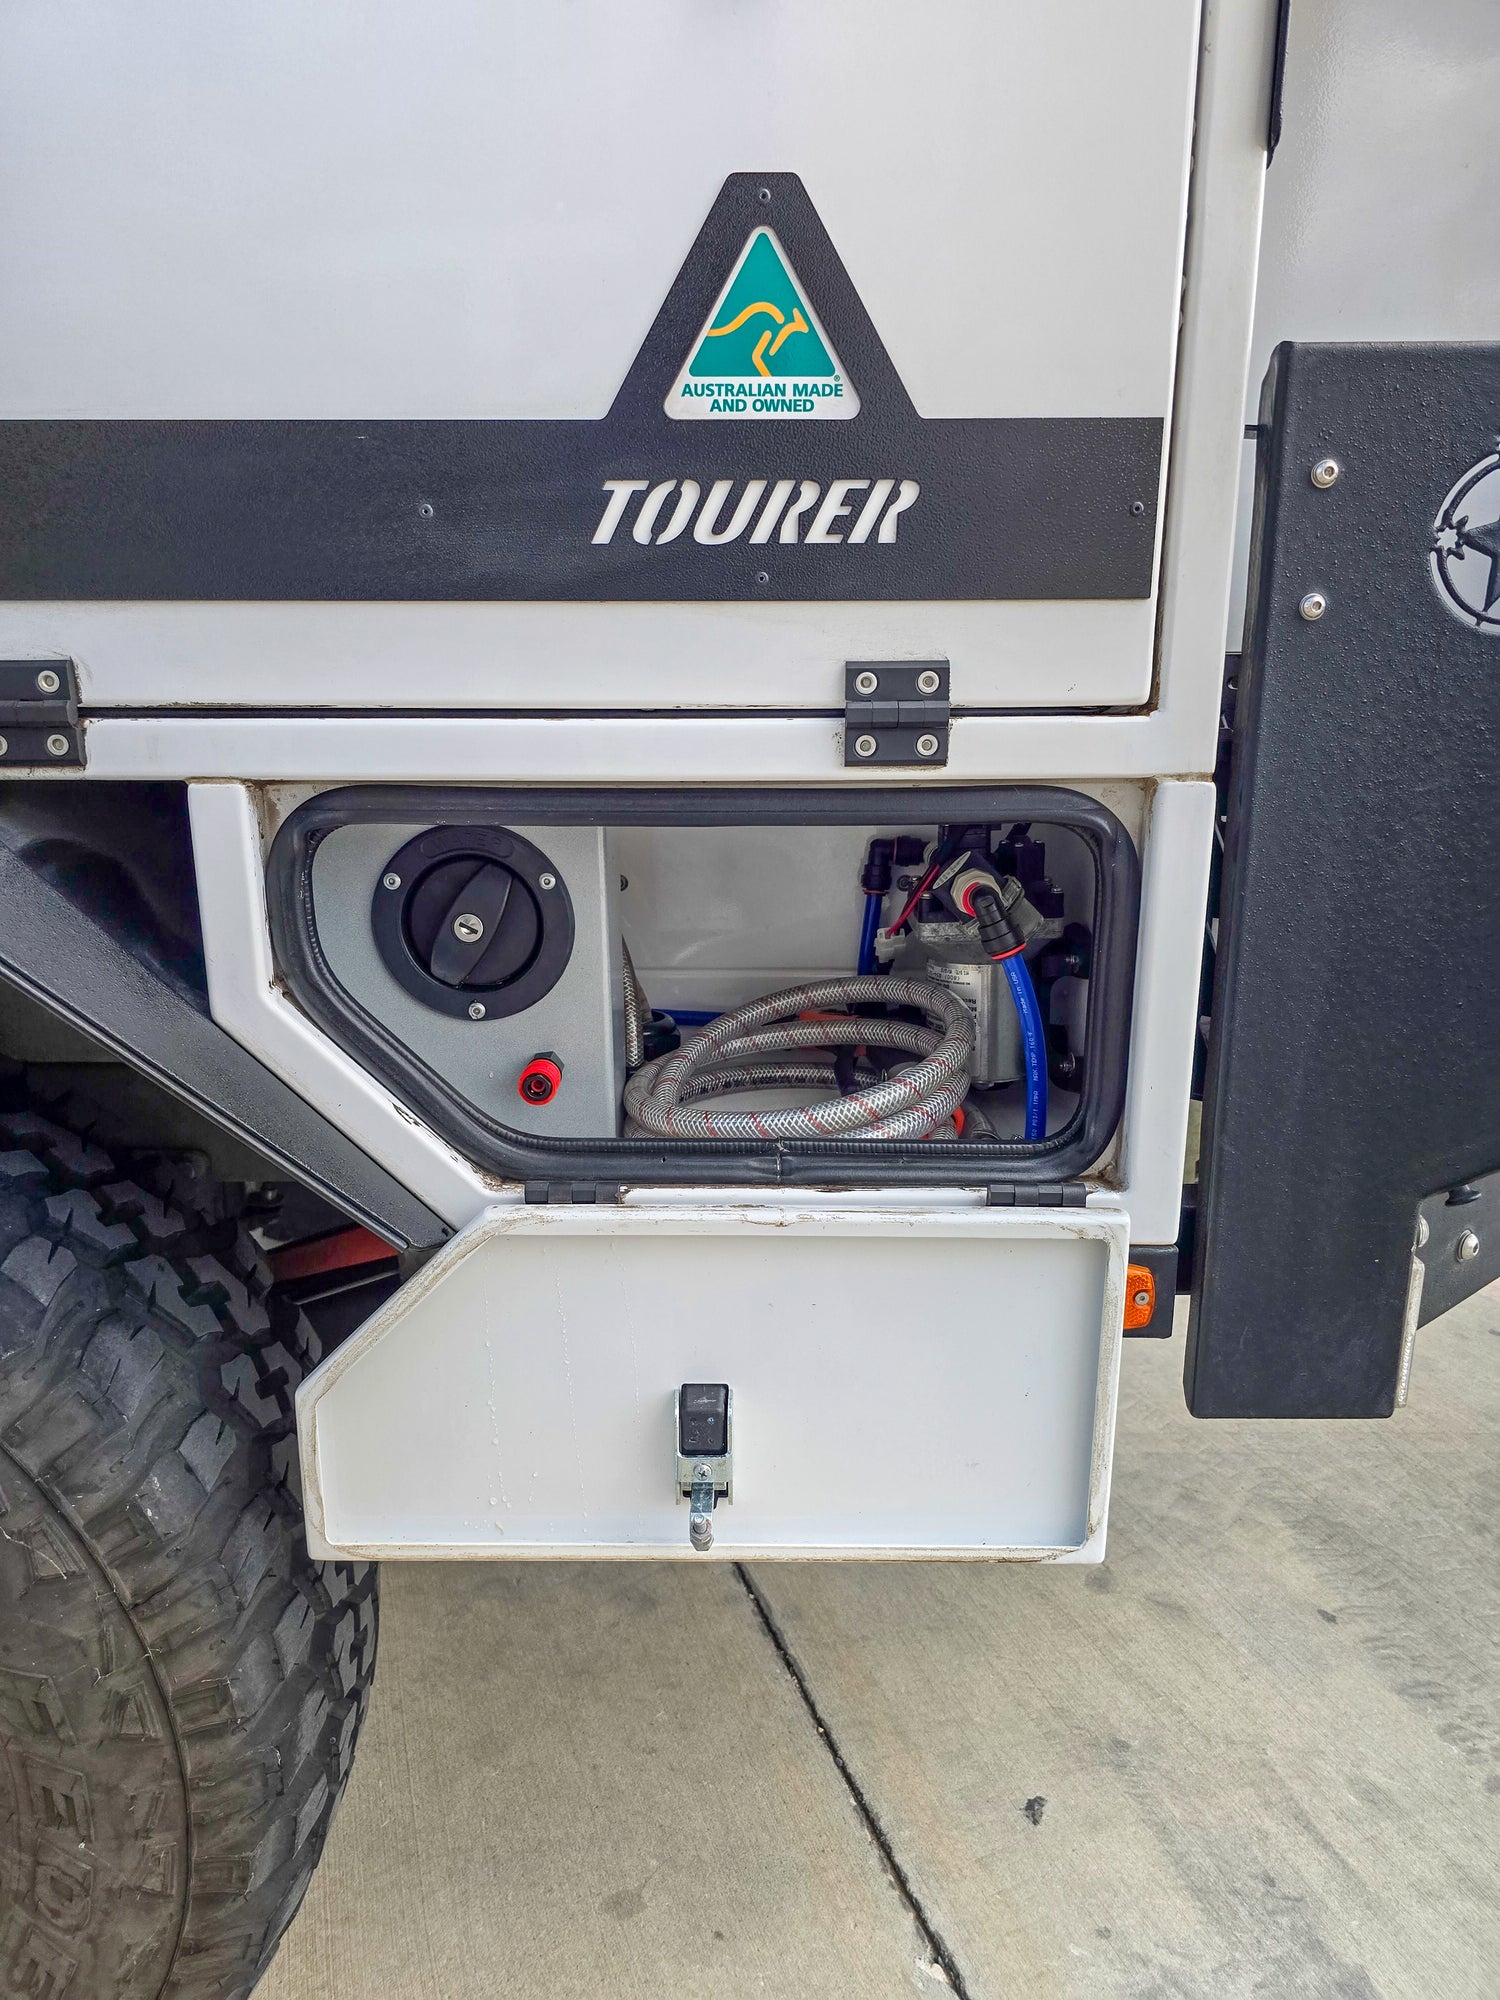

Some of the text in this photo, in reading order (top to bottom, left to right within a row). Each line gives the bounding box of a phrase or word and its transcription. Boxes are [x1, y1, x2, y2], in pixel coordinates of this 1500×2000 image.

[681, 383, 843, 397] AUSTRALIAN MADE
[709, 398, 815, 412] AND OWNED
[591, 479, 921, 545] TOURER
